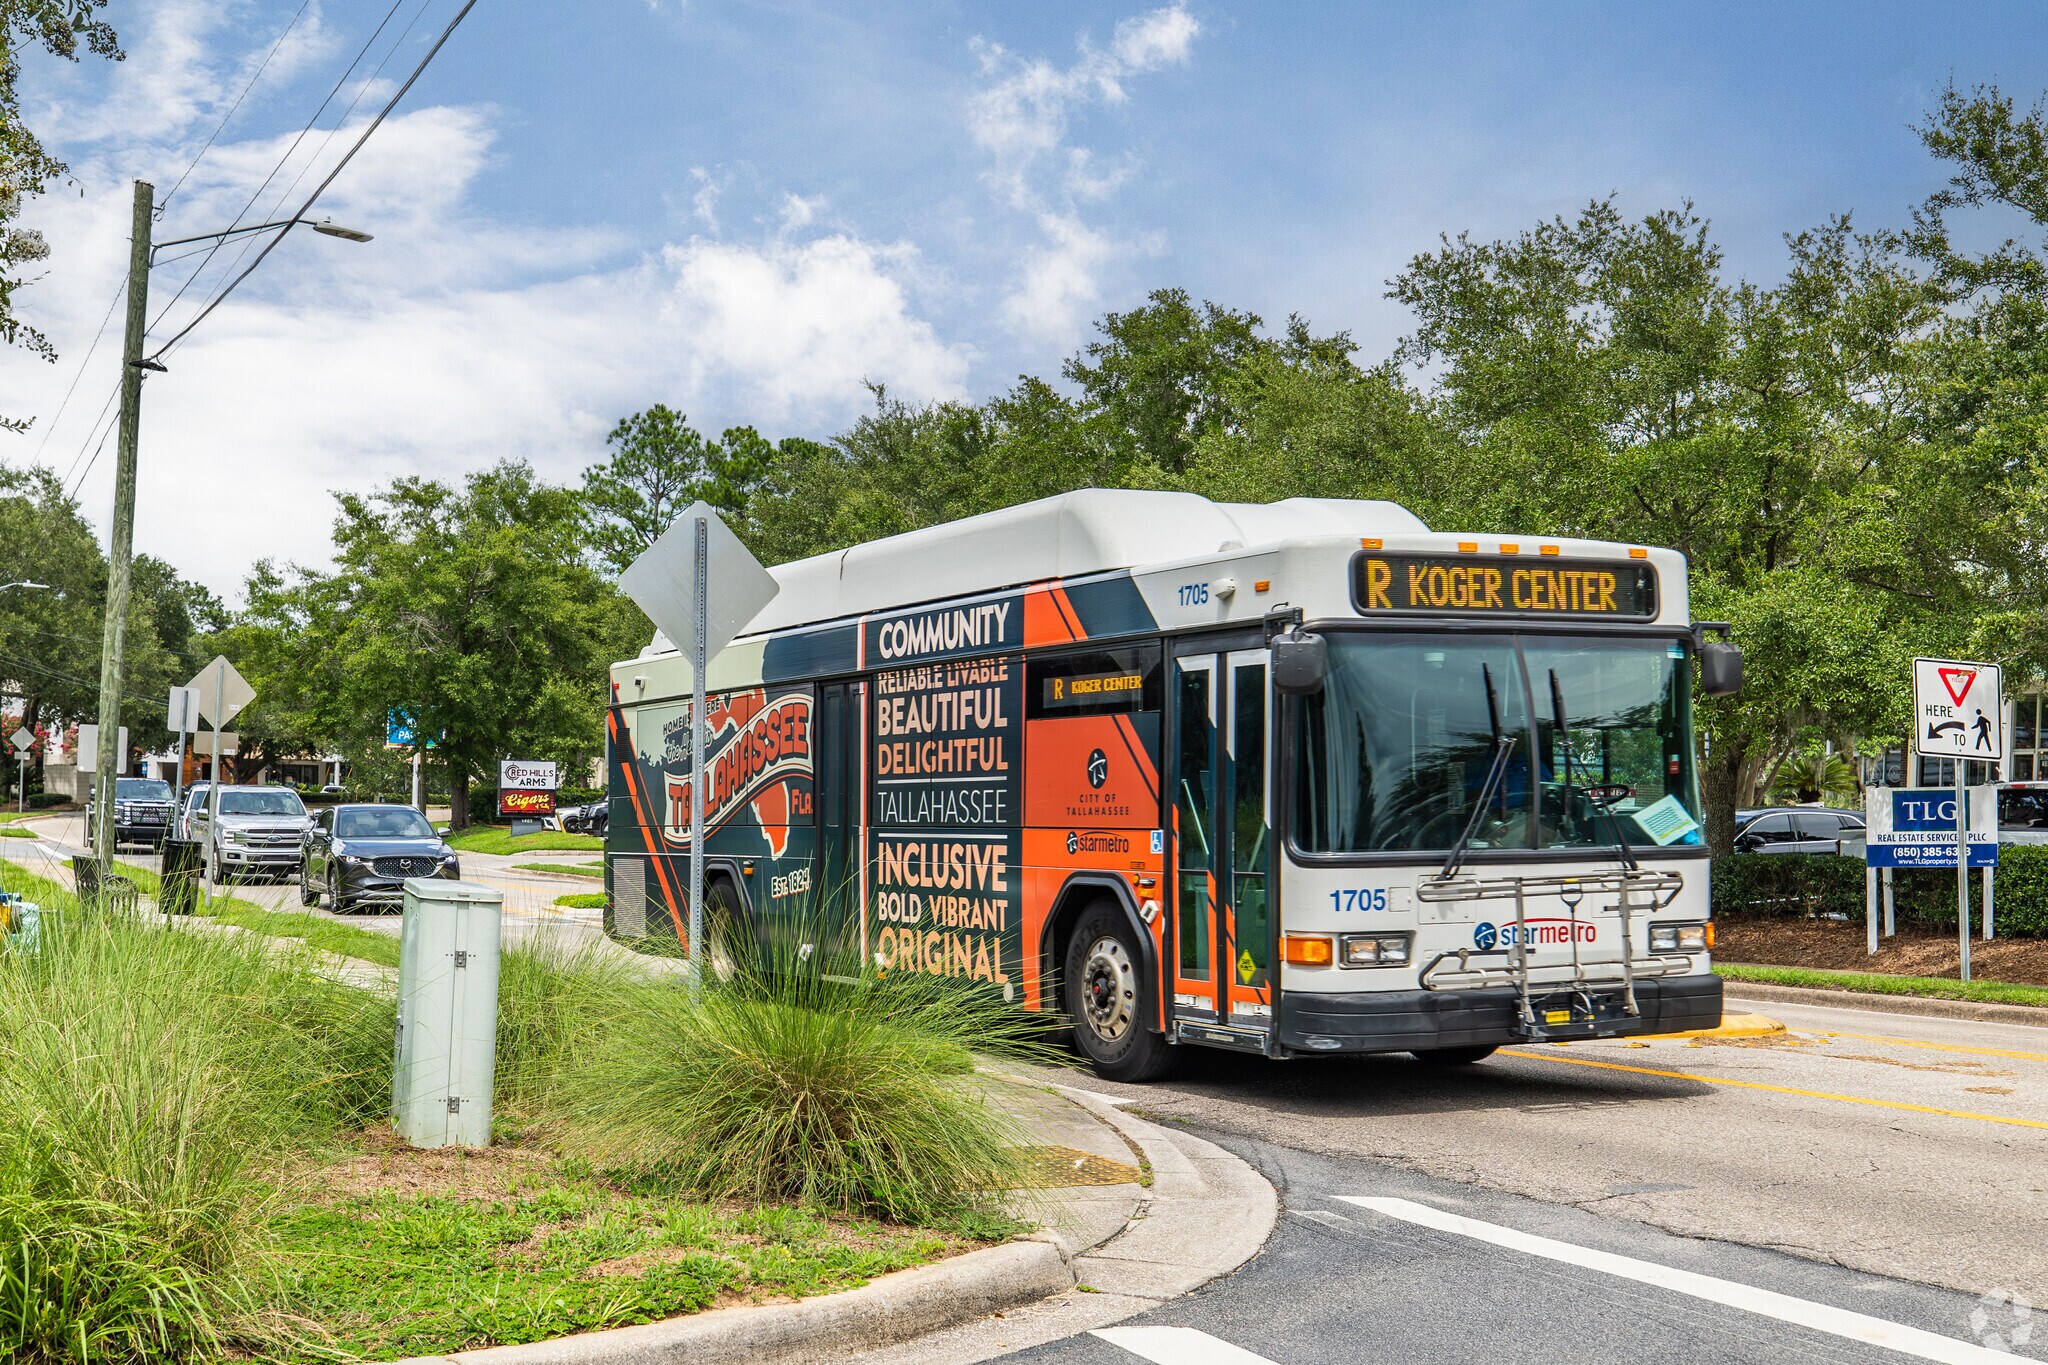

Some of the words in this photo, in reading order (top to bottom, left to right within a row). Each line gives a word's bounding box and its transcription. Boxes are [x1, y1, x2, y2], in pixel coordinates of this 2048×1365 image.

[1178, 583, 1208, 606] 1705
[1367, 560, 1392, 608] R
[1409, 565, 1503, 608] KOGER
[1512, 569, 1617, 611] CENTER
[879, 602, 1010, 659] COMMUNITY
[878, 664, 943, 694] RELIABLE
[946, 657, 1009, 687] LIVABLE
[1054, 677, 1063, 700] R
[1071, 679, 1101, 694] KOGER
[1103, 675, 1142, 692] CENTER
[878, 687, 1008, 736] BEAUTIFUL
[1925, 704, 1954, 718] HERE
[662, 715, 683, 736] HOME
[1953, 734, 1966, 746] TO
[878, 736, 1009, 775] DELIGHTFUL
[511, 769, 528, 777] RED
[530, 769, 554, 777] HILLS
[668, 702, 809, 834] TALAHASSEE
[519, 778, 546, 787] ARMS
[505, 794, 550, 809] Cigars
[878, 789, 1008, 824] TALLAHASSEE
[1079, 794, 1099, 803] CITY
[1104, 794, 1116, 803] OF
[1067, 806, 1129, 816] TALLAHASSEE
[1901, 801, 1958, 821] TLG
[1079, 834, 1129, 854] starmetro
[1877, 833, 1896, 842] REAL
[1899, 833, 1924, 842] ESTATE
[1927, 833, 1958, 841] SERVICE
[1968, 833, 1986, 841] PLLC
[1893, 847, 1920, 858] (850)
[1922, 847, 1971, 857] 385-633
[878, 842, 1008, 892] INCLUSIVE
[878, 891, 922, 924] BOLD
[928, 895, 1008, 932] VIBRANT
[1330, 889, 1386, 912] 1705
[1501, 924, 1596, 946] starmero
[878, 925, 1009, 984] ORIGINAL
